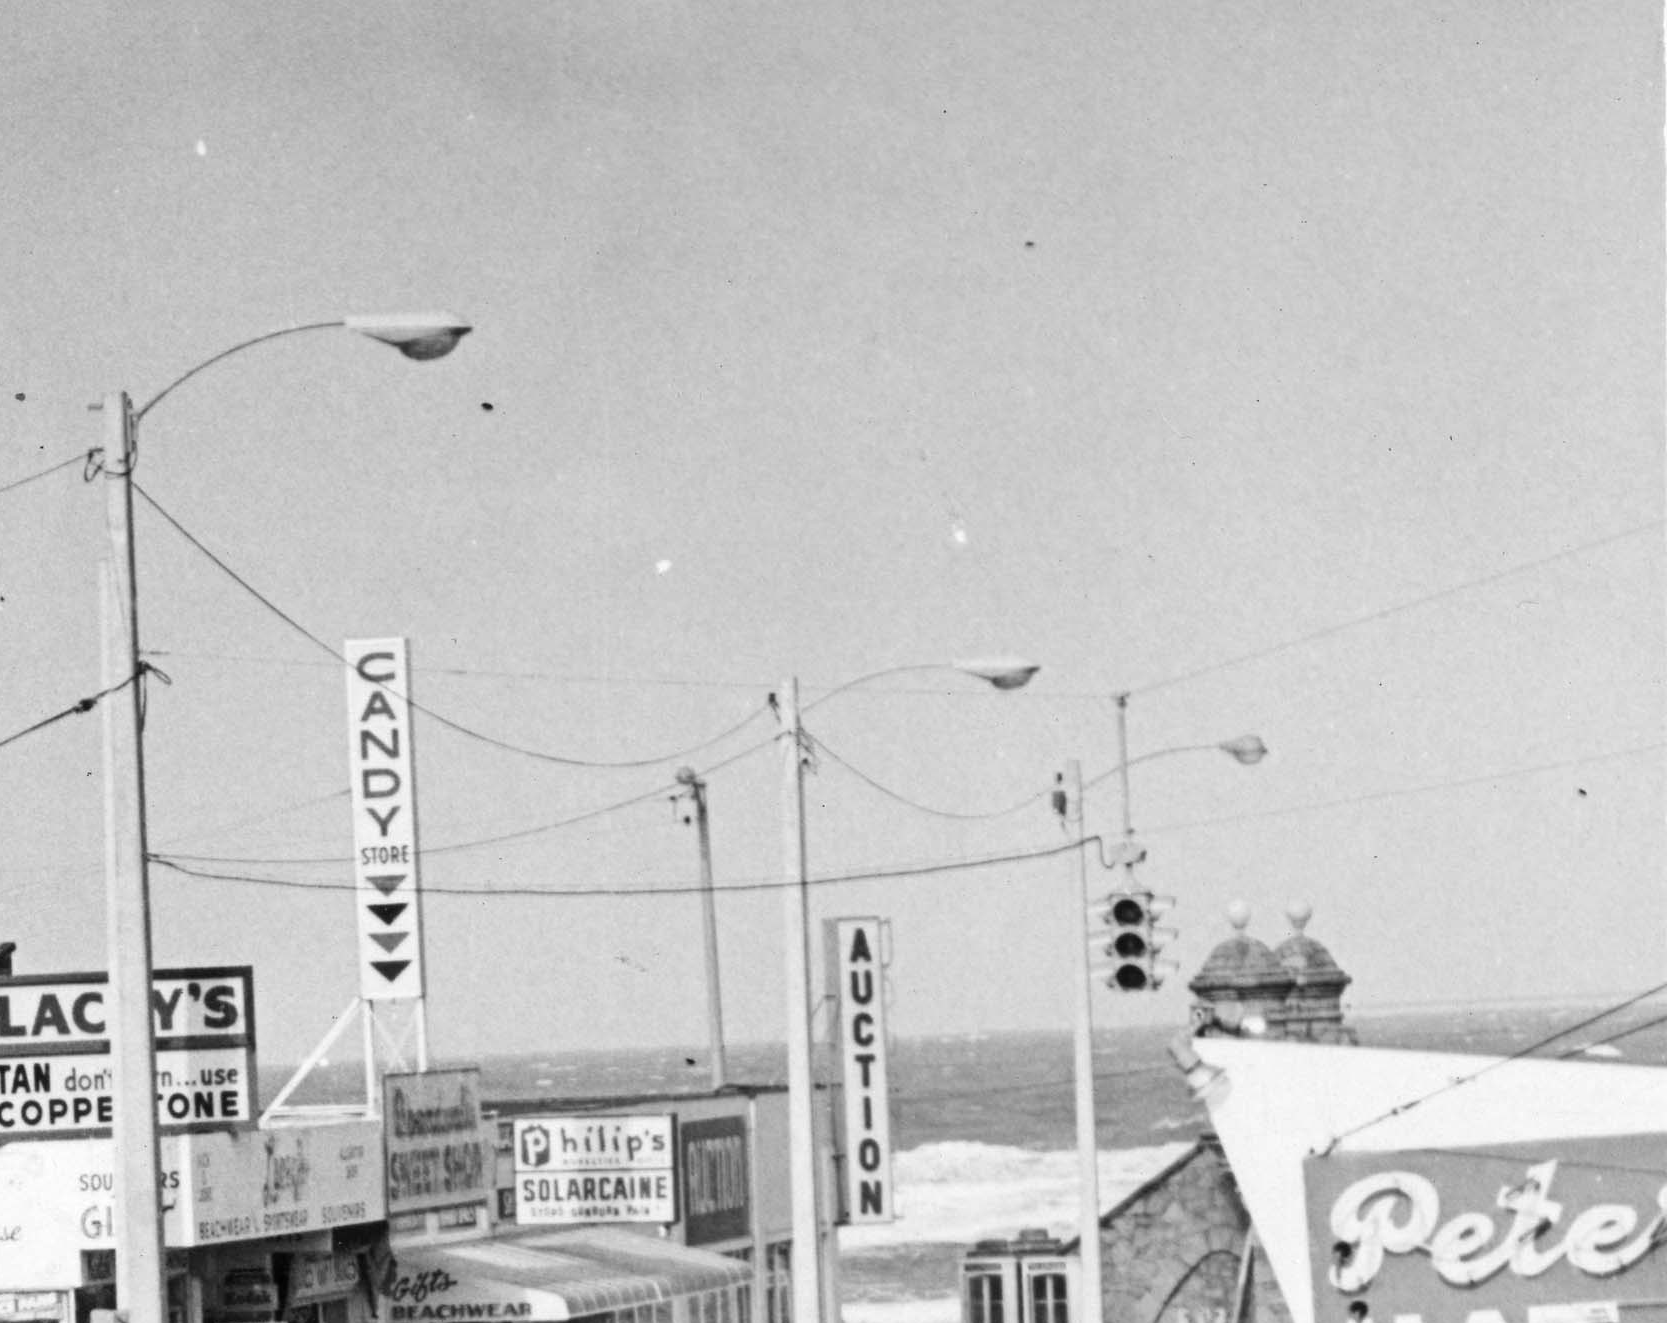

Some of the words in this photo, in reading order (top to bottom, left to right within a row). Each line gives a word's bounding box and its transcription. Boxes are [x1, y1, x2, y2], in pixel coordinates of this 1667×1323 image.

[356, 652, 402, 837] CANDY
[361, 846, 410, 864] STORE
[850, 928, 883, 1215] AUCTION
[79, 1171, 180, 1191] SOURS
[523, 1176, 668, 1203] SOLARCAINE
[199, 1216, 252, 1240] BEACHWEAR
[390, 1269, 458, 1301] Gifts
[391, 1302, 533, 1320] BEACHWEAR
